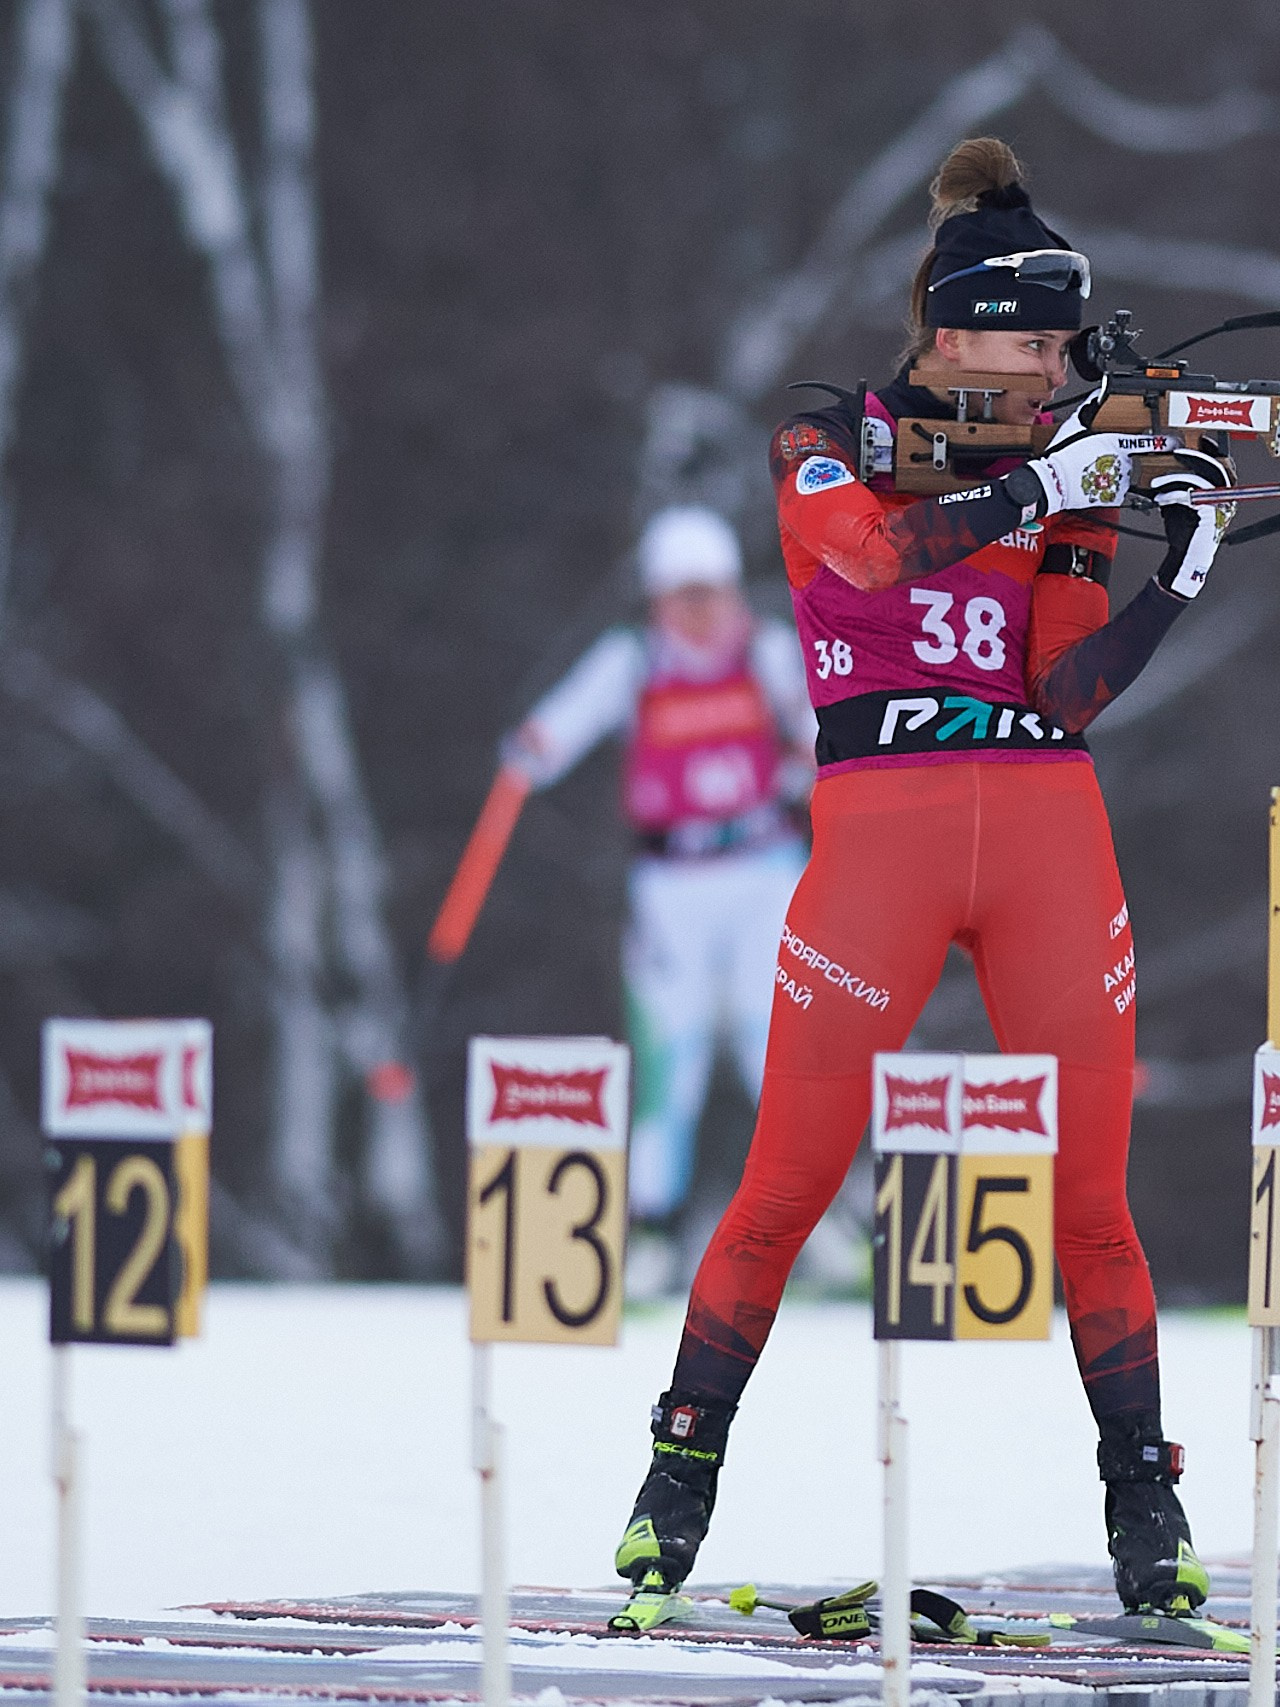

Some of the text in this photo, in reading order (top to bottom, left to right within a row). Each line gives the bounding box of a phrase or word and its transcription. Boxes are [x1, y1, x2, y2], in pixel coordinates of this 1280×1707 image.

[974, 300, 1018, 314] PARI
[813, 639, 854, 679] 38
[909, 587, 1007, 671] 38
[53, 1153, 170, 1335] 12
[479, 1148, 611, 1328] 13
[876, 1154, 955, 1326] 14
[963, 1177, 1034, 1325] 5
